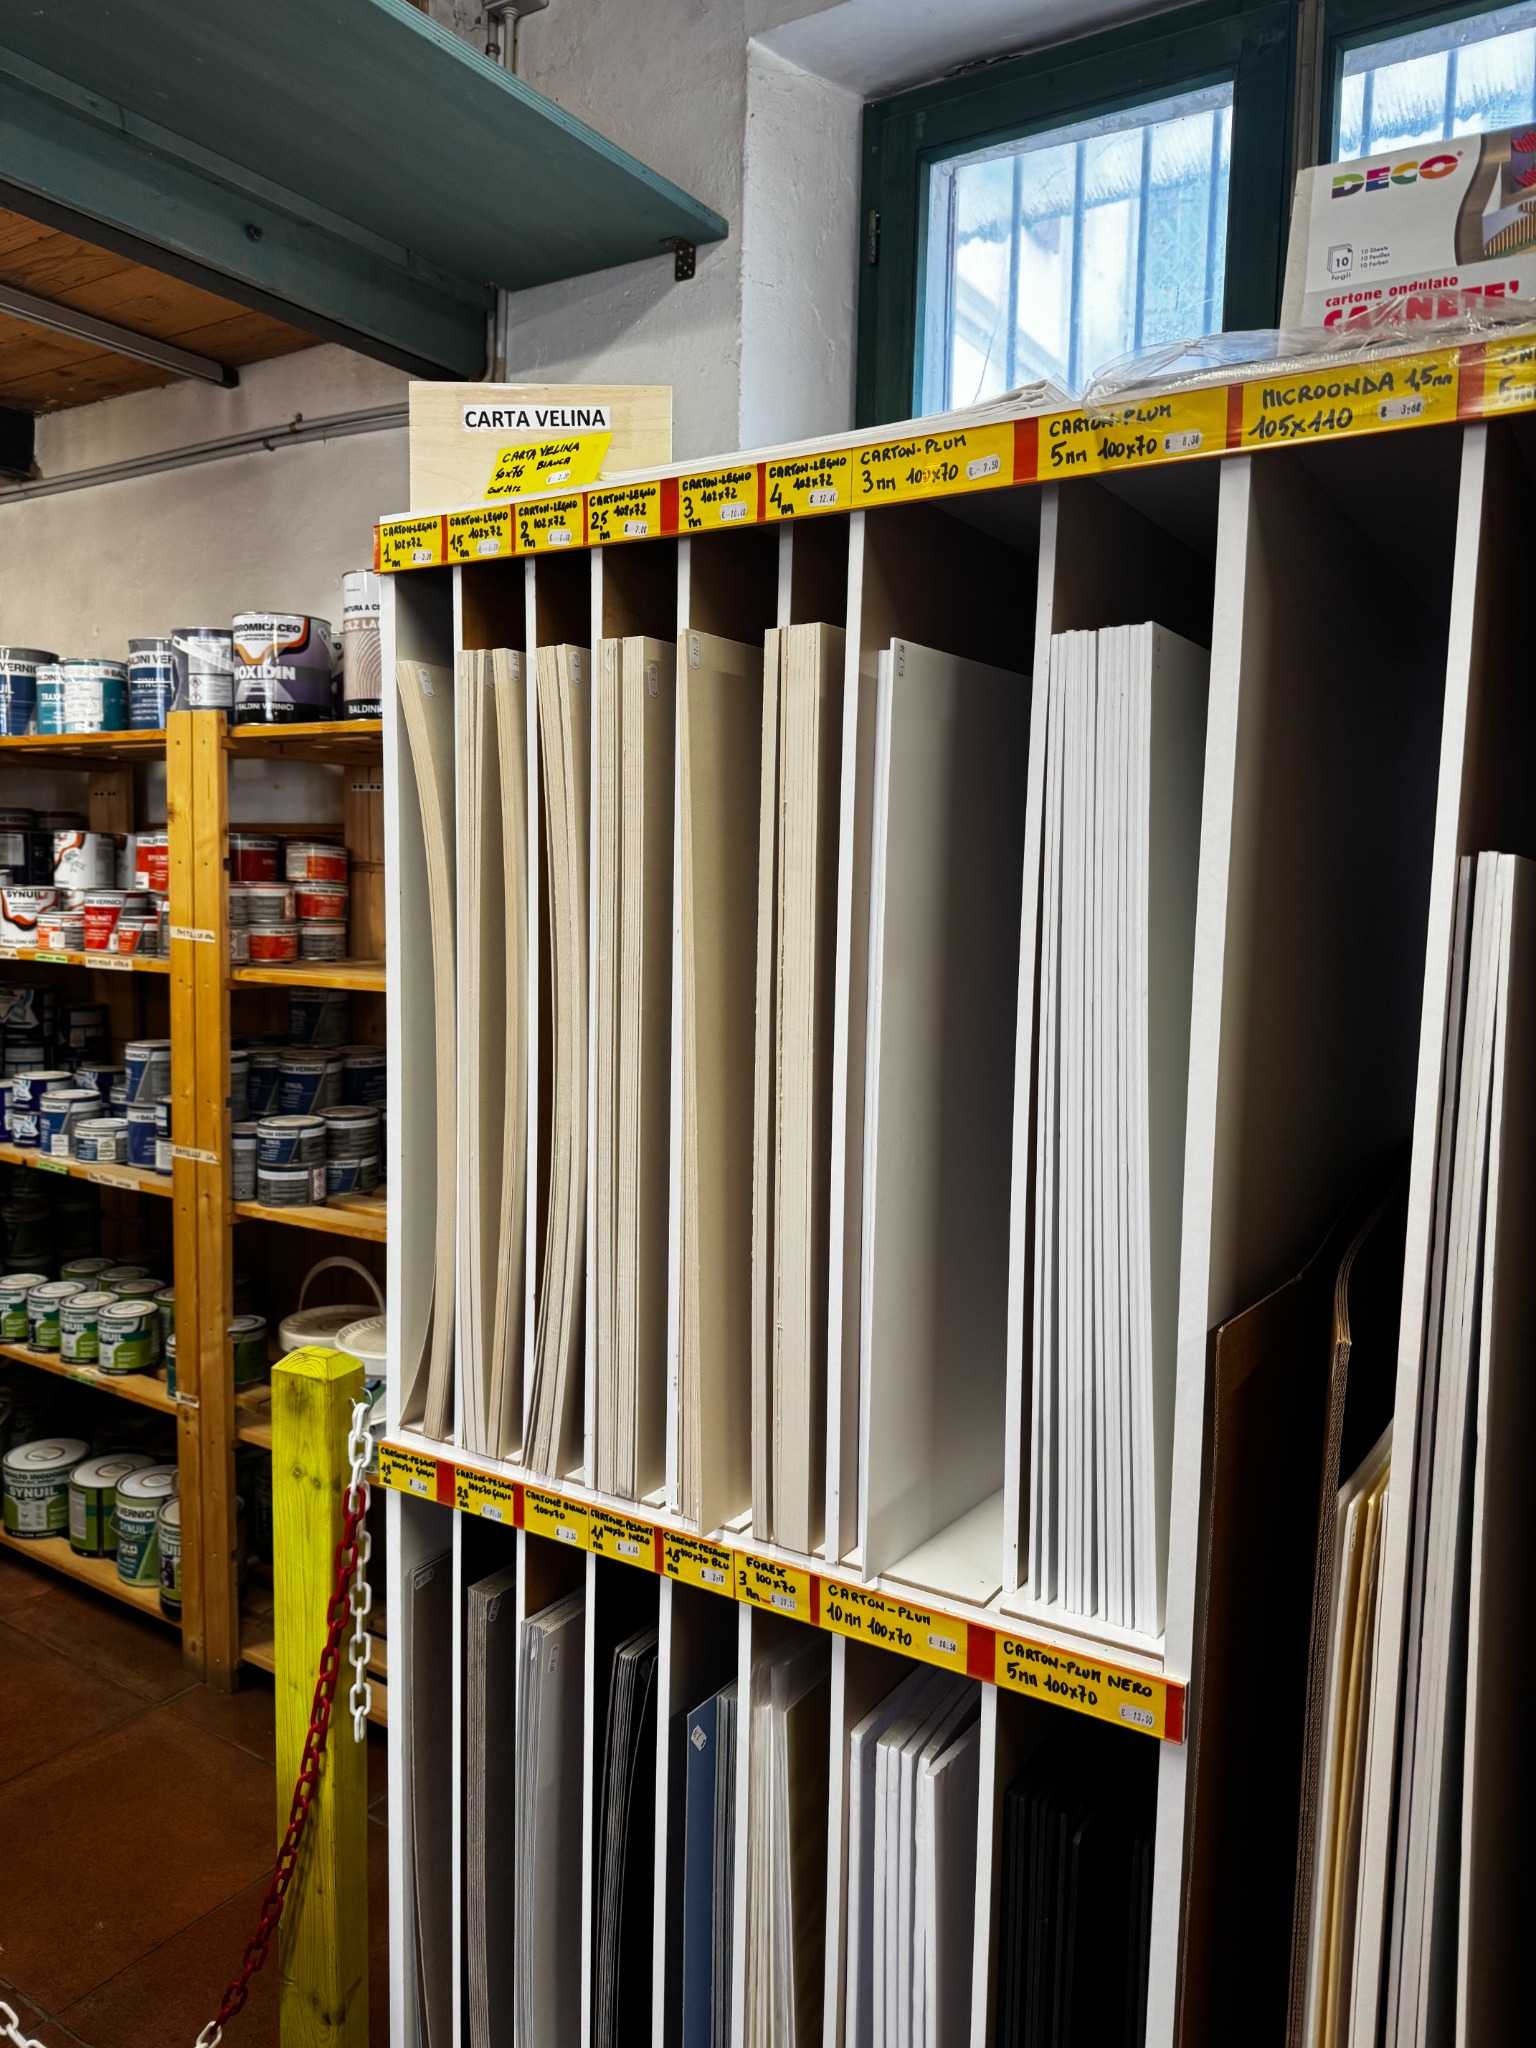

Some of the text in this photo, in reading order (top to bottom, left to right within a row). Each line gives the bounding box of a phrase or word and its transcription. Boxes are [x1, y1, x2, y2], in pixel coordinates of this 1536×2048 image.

[1331, 154, 1458, 199] DECO
[1335, 257, 1349, 268] 10
[1331, 272, 1351, 281] fogli
[1325, 276, 1458, 308] cartone ondulato
[1262, 371, 1394, 410] MICROONDA
[465, 409, 606, 427] CARTA VELINA
[1248, 407, 1354, 439] 105x110
[502, 442, 580, 463] CARTA VELINA
[1097, 434, 1158, 460] 100x70
[536, 456, 571, 470] BIANCA
[983, 460, 999, 473] 7.50
[793, 473, 833, 490] 102x72
[700, 487, 737, 503] 102x72
[770, 483, 782, 509] 4
[613, 502, 646, 517] 102x72
[683, 496, 693, 519] 3
[520, 520, 529, 539] 2
[534, 515, 566, 529] 102x72
[590, 510, 609, 531] 2,5
[468, 525, 503, 539] 102x72
[383, 543, 392, 563] 1
[394, 537, 423, 551] 102x72
[450, 534, 464, 553] 1,5
[9, 1485, 58, 1498] SYNUIL
[468, 1481, 492, 1495] 100x70
[526, 1490, 588, 1515] CARTONE BIANCO
[534, 1504, 565, 1520] 100x70
[629, 1532, 650, 1545] NERO
[664, 1531, 730, 1561] CARTONE PESANTE
[712, 1557, 729, 1570] BLU
[746, 1557, 786, 1578] FOREX
[739, 1570, 796, 1594] 3 100x70
[867, 1616, 912, 1647] 100x70
[1003, 1640, 1153, 1698] CARTON-PLUM NERO
[1043, 1675, 1098, 1706] 100x70
[1133, 1711, 1153, 1725] 13.50
